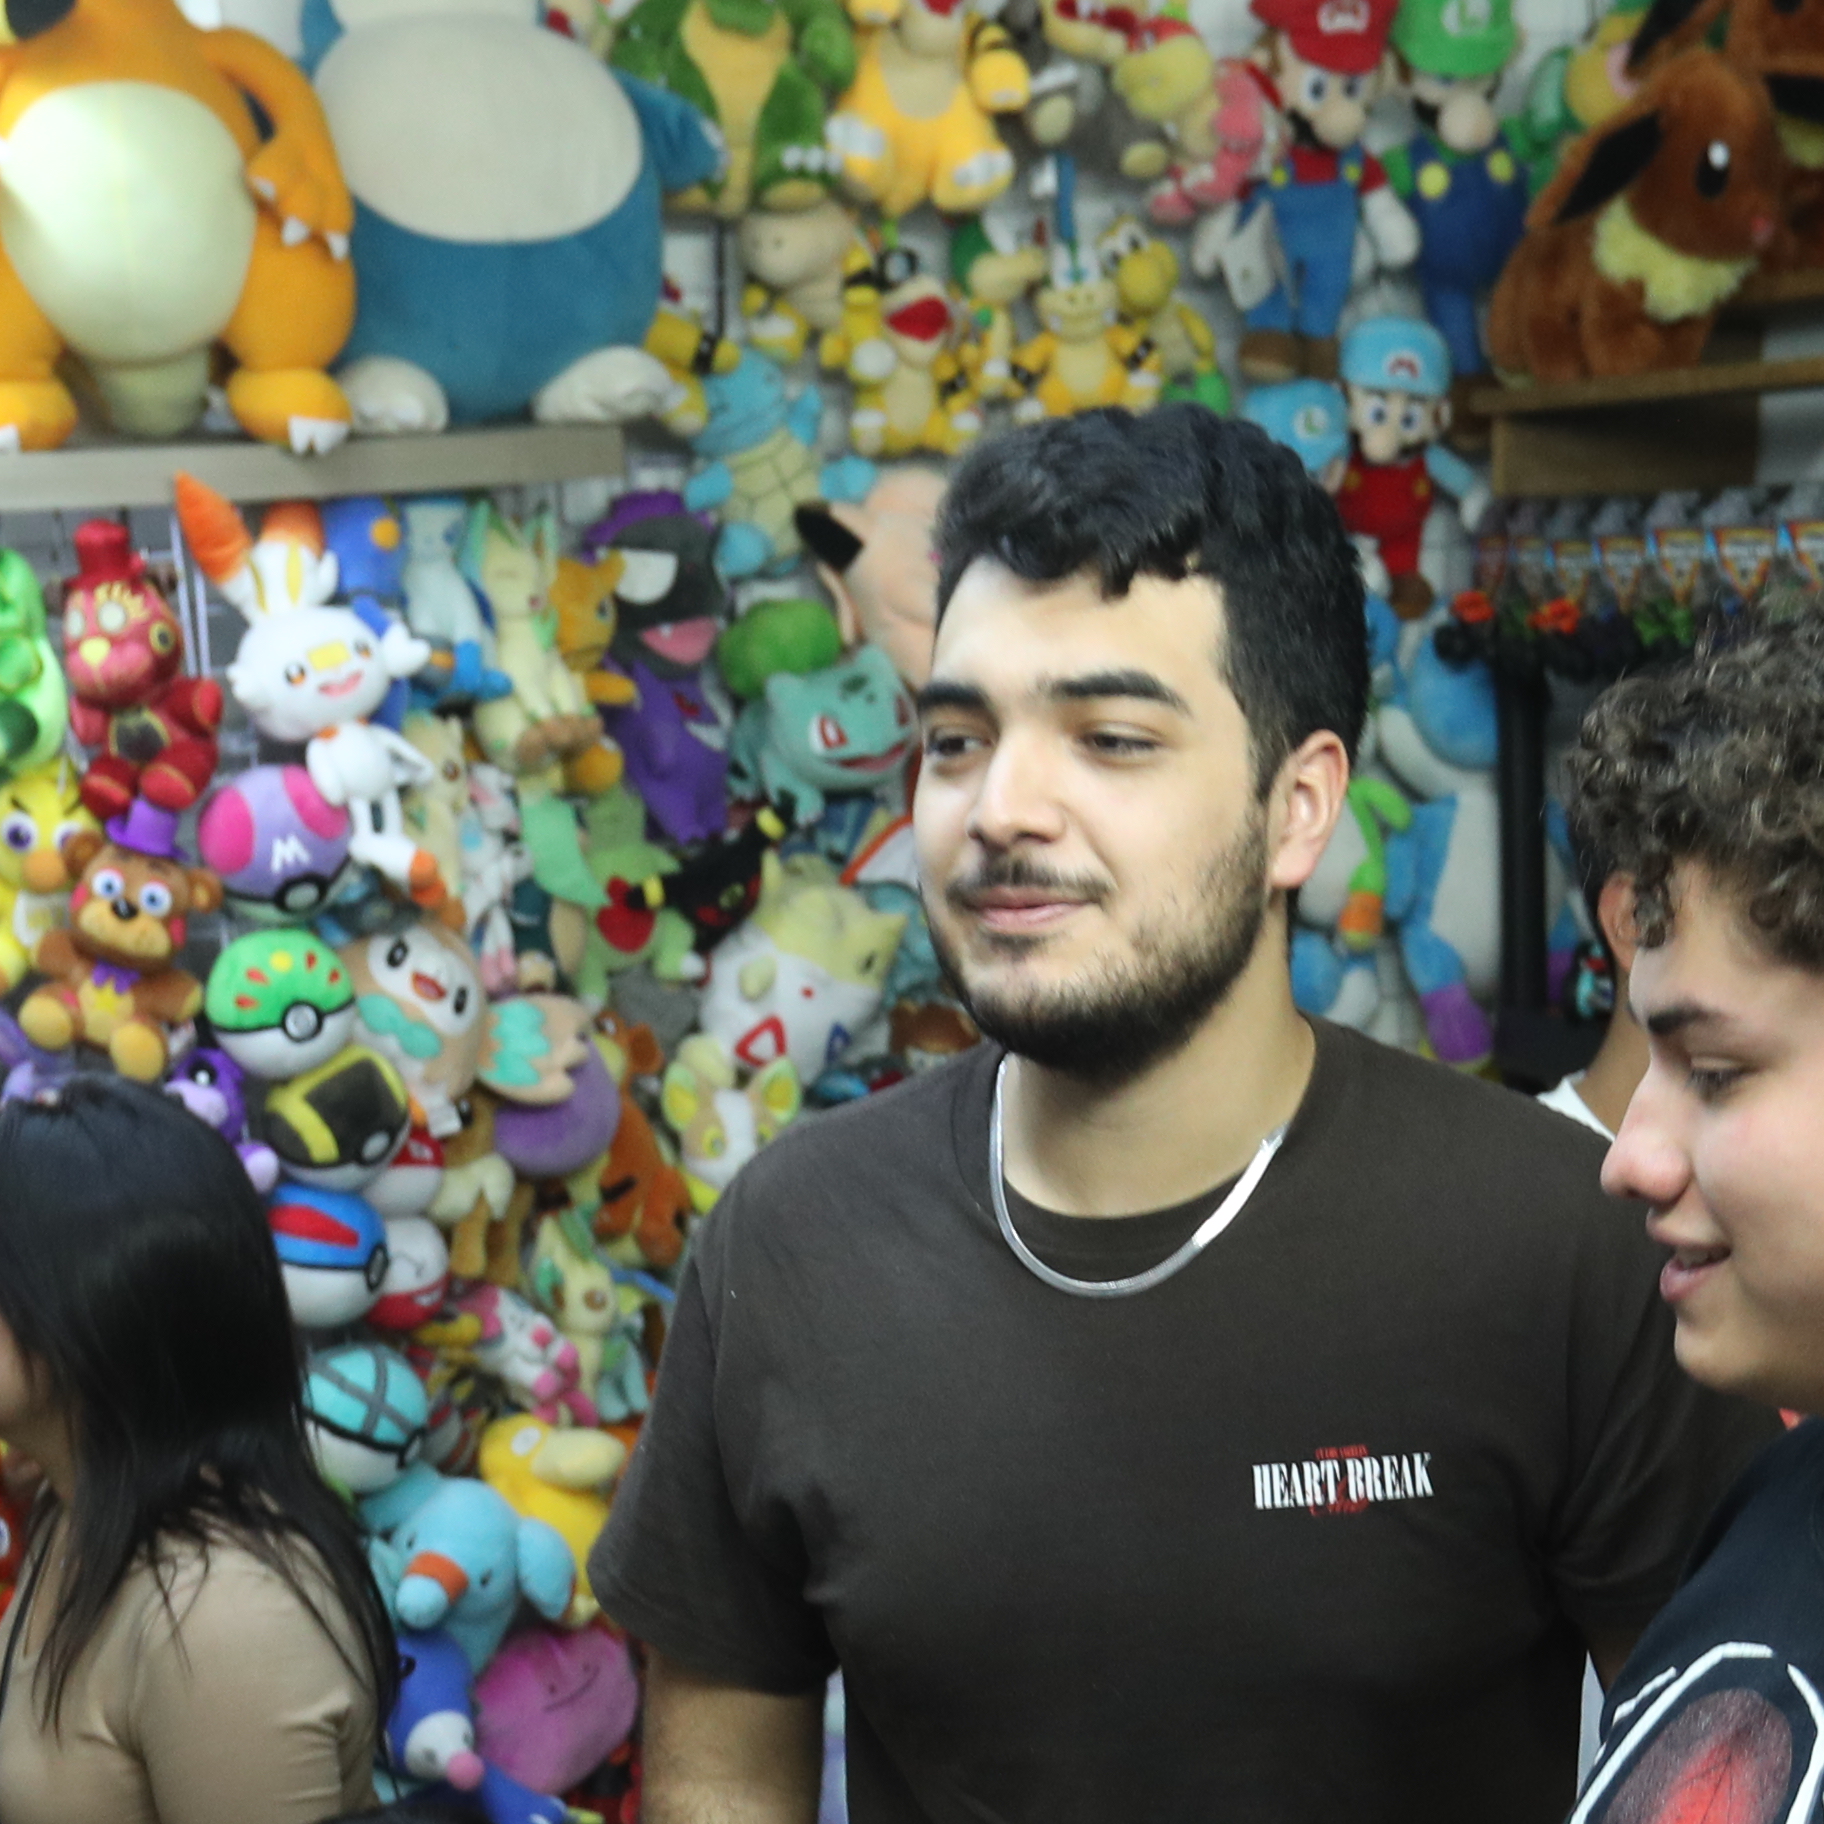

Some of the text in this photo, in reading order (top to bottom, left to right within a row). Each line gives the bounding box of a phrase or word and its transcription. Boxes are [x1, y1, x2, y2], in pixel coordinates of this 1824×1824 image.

[270, 833, 312, 874] M
[1252, 1452, 1434, 1510] HEART BREAK
